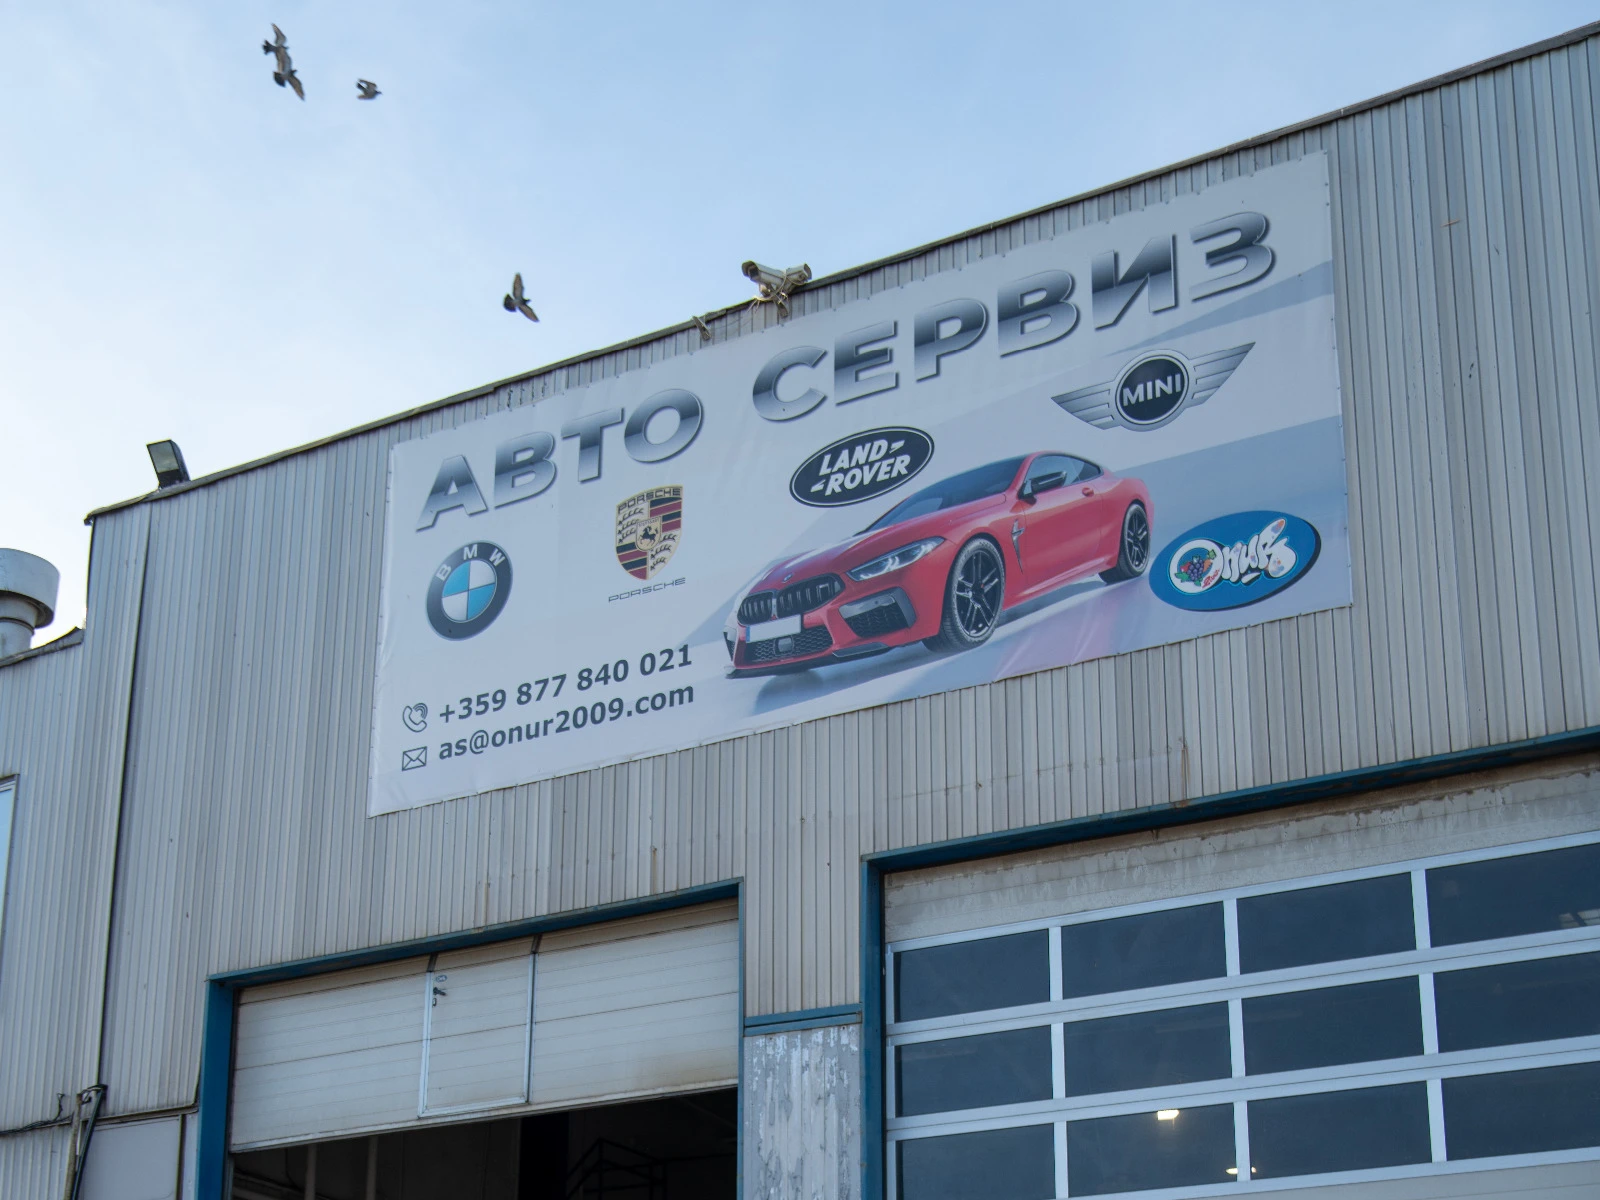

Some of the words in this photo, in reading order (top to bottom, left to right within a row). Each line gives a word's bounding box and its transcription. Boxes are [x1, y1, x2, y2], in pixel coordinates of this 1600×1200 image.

[416, 388, 704, 532] АВТО
[752, 210, 1276, 423] СЕРВИЗ
[1122, 373, 1182, 407] MINI
[819, 439, 889, 476] LAND
[824, 454, 911, 496] ROVER
[618, 488, 681, 514] PORSCHE
[436, 544, 506, 581] BMW
[608, 577, 686, 602] PORSCHE
[439, 689, 507, 723] +359
[516, 674, 567, 705] 877
[576, 659, 629, 691] 840
[640, 644, 692, 676] 021
[438, 685, 694, 760] as@onur2009.com
